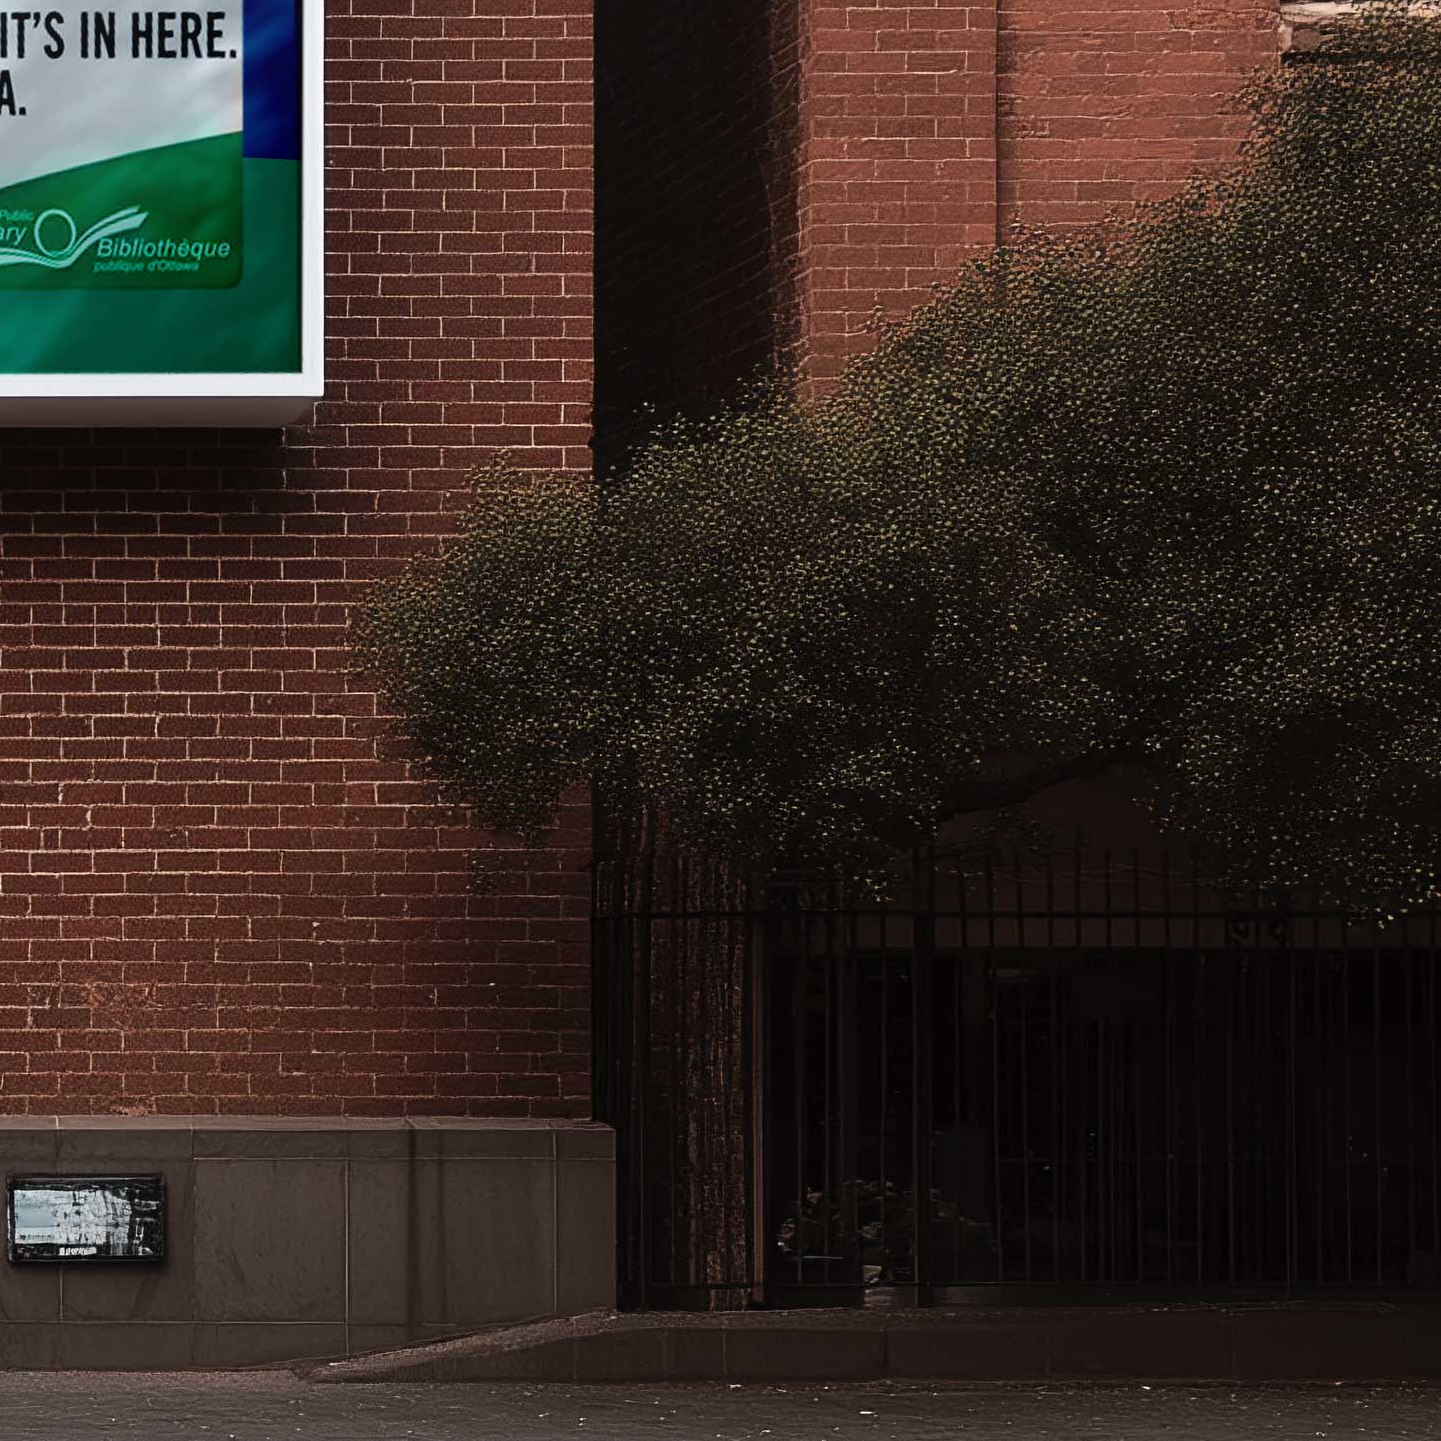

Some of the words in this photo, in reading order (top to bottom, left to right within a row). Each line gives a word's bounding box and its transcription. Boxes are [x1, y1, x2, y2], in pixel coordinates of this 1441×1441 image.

[80, 11, 116, 60] IN
[131, 11, 237, 59] HERE.
[97, 238, 230, 260] Bibliothèque
